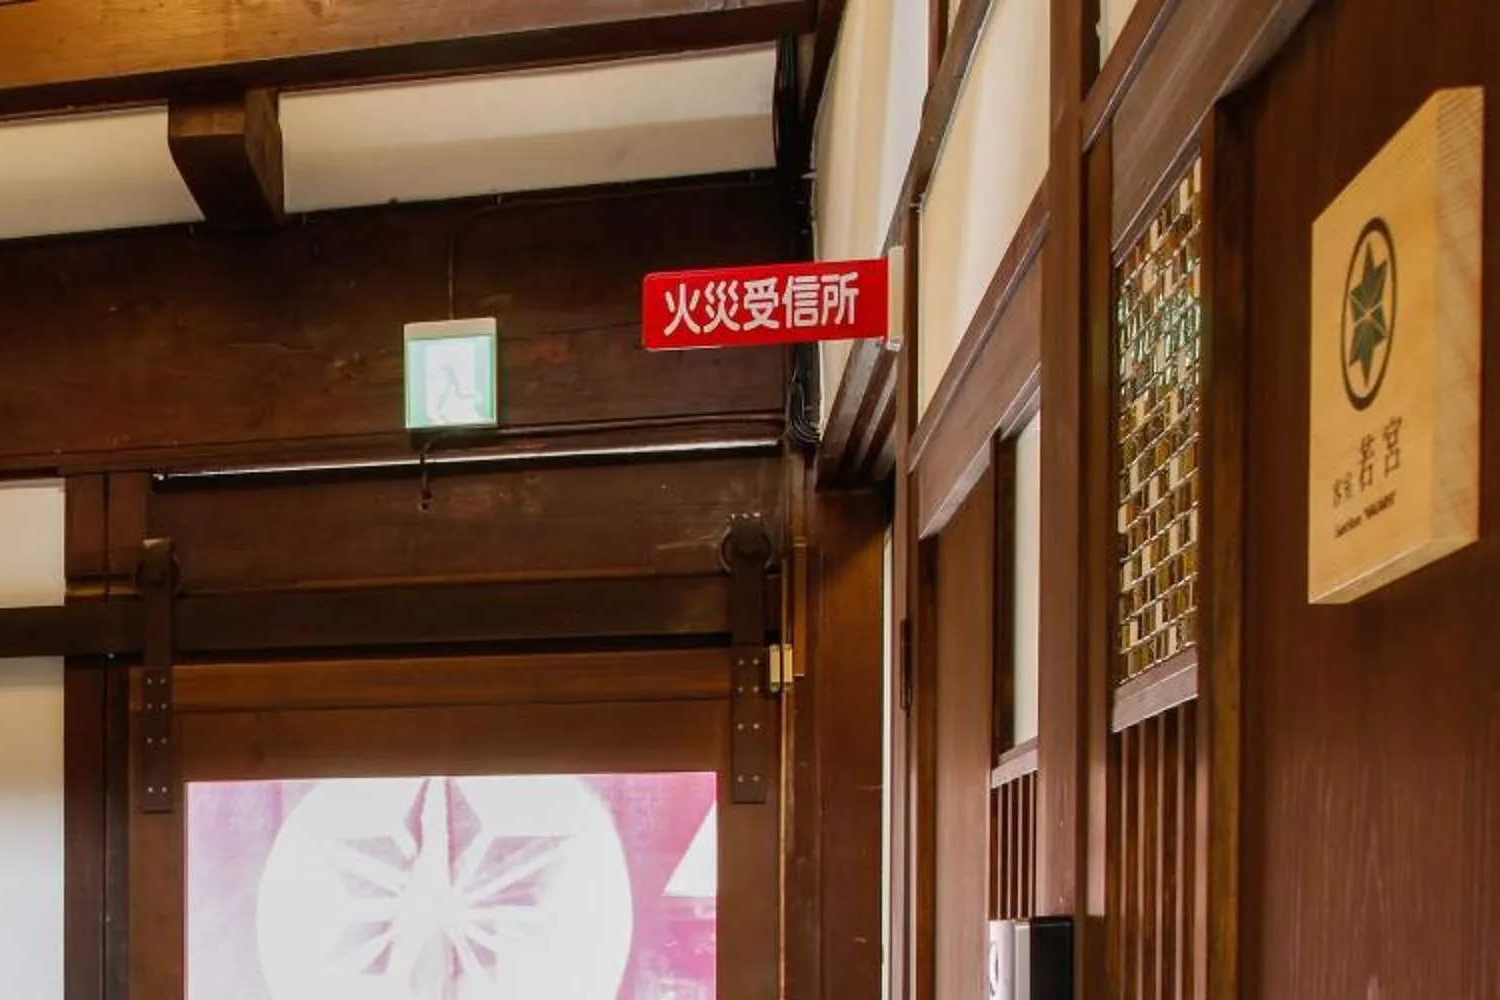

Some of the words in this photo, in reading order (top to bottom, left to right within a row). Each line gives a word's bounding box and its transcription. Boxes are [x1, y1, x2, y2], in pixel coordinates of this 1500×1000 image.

[663, 271, 860, 337] 火災受信所
